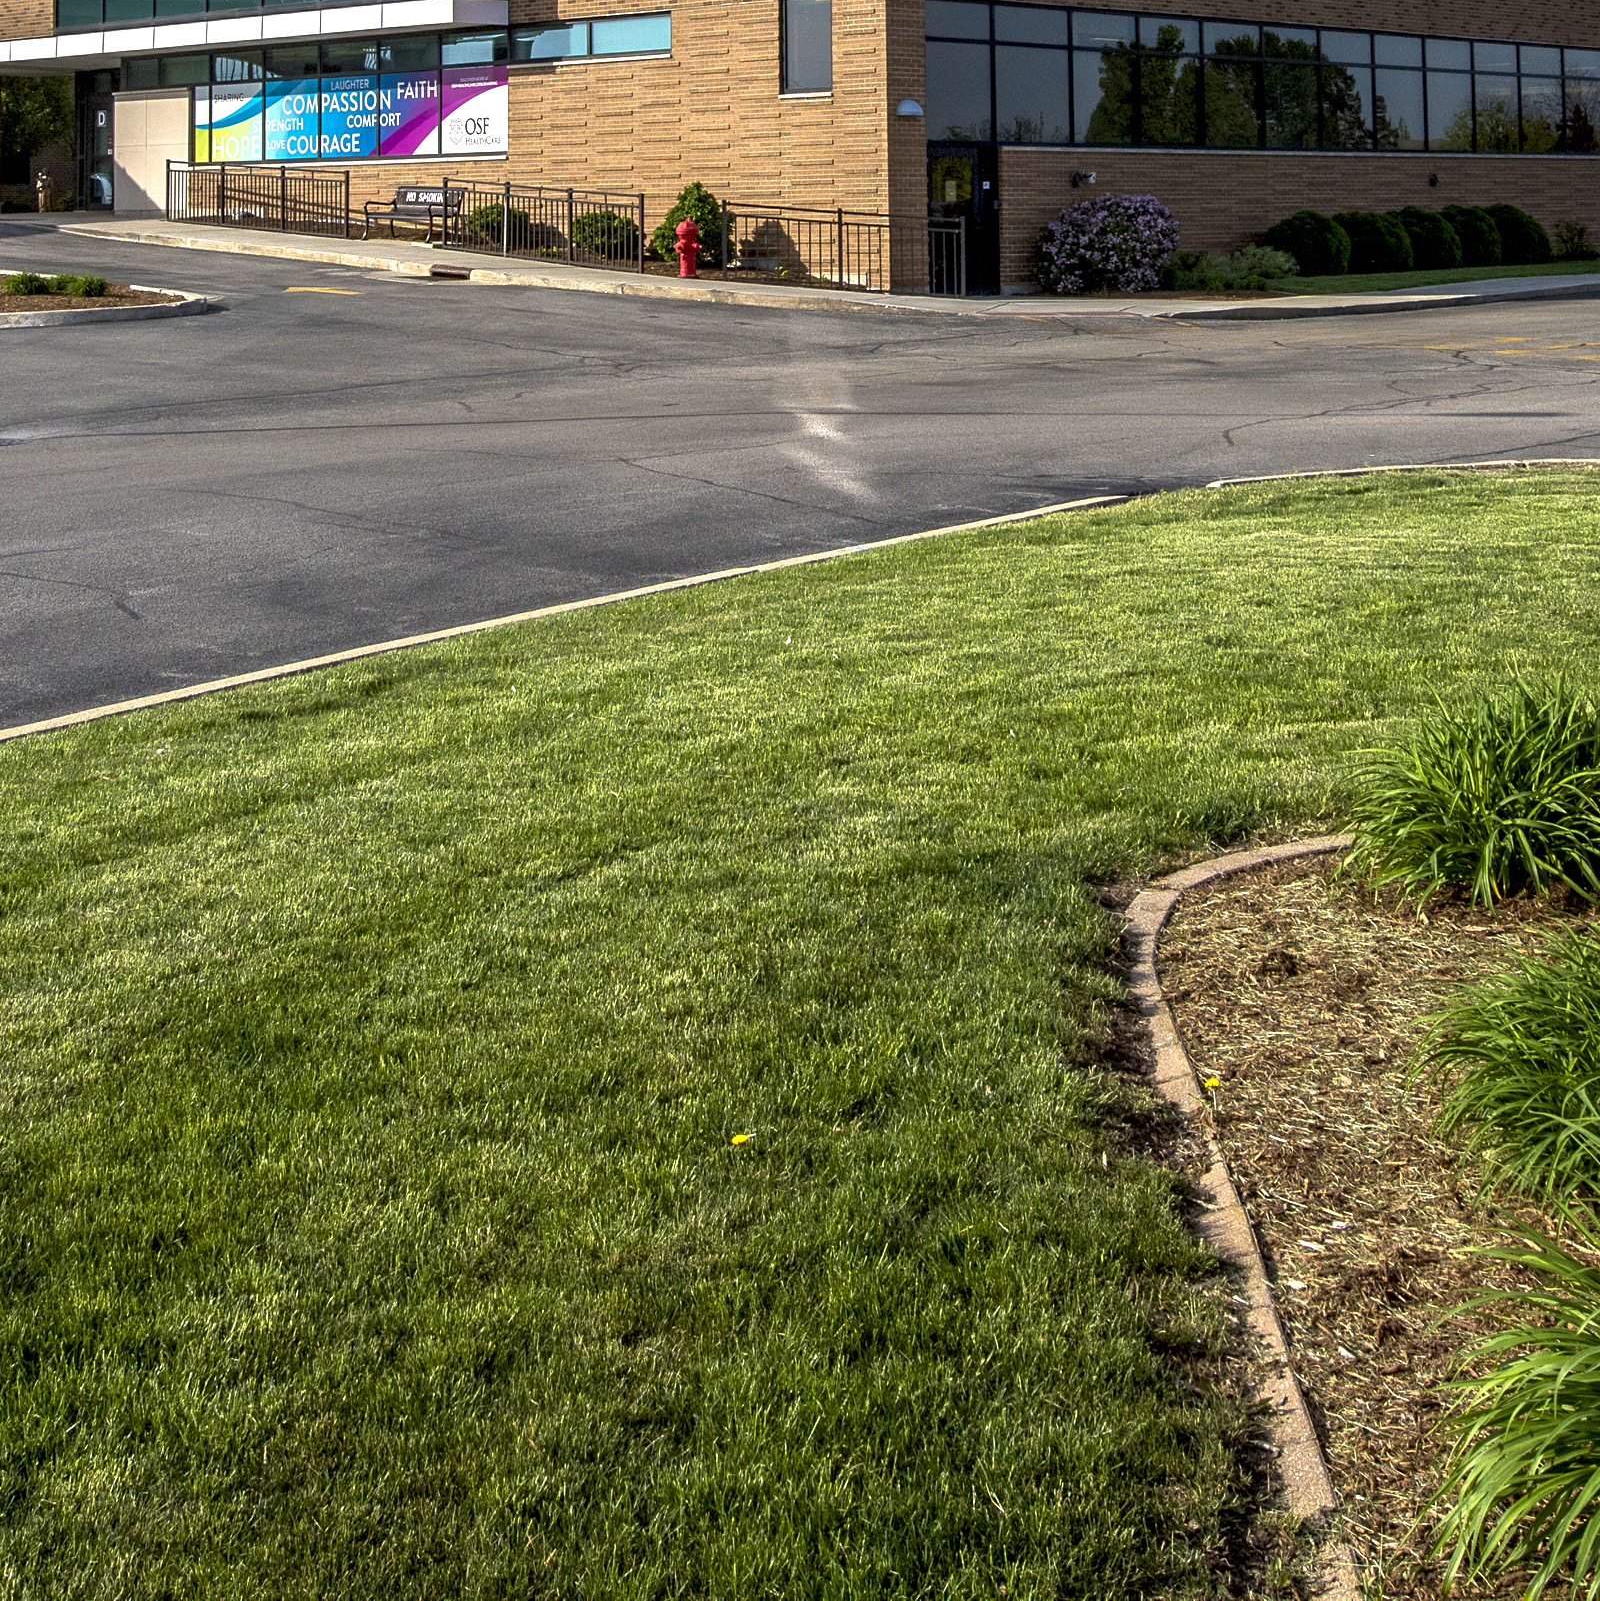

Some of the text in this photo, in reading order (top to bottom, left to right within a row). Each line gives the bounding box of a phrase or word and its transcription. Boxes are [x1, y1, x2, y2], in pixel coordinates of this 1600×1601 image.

[331, 79, 369, 90] LAUGHTER
[396, 80, 437, 100] FAITH
[214, 93, 244, 103] SHARING
[282, 90, 391, 115] COMPASSION
[98, 112, 106, 126] D
[253, 117, 304, 133] STRENGTH
[346, 112, 401, 129] COMFORT
[465, 117, 489, 135] OSF
[213, 135, 261, 159] HOPE
[267, 139, 285, 150] LOVE
[286, 133, 360, 155] COURAGE
[406, 191, 446, 203] NO SMOKIN
